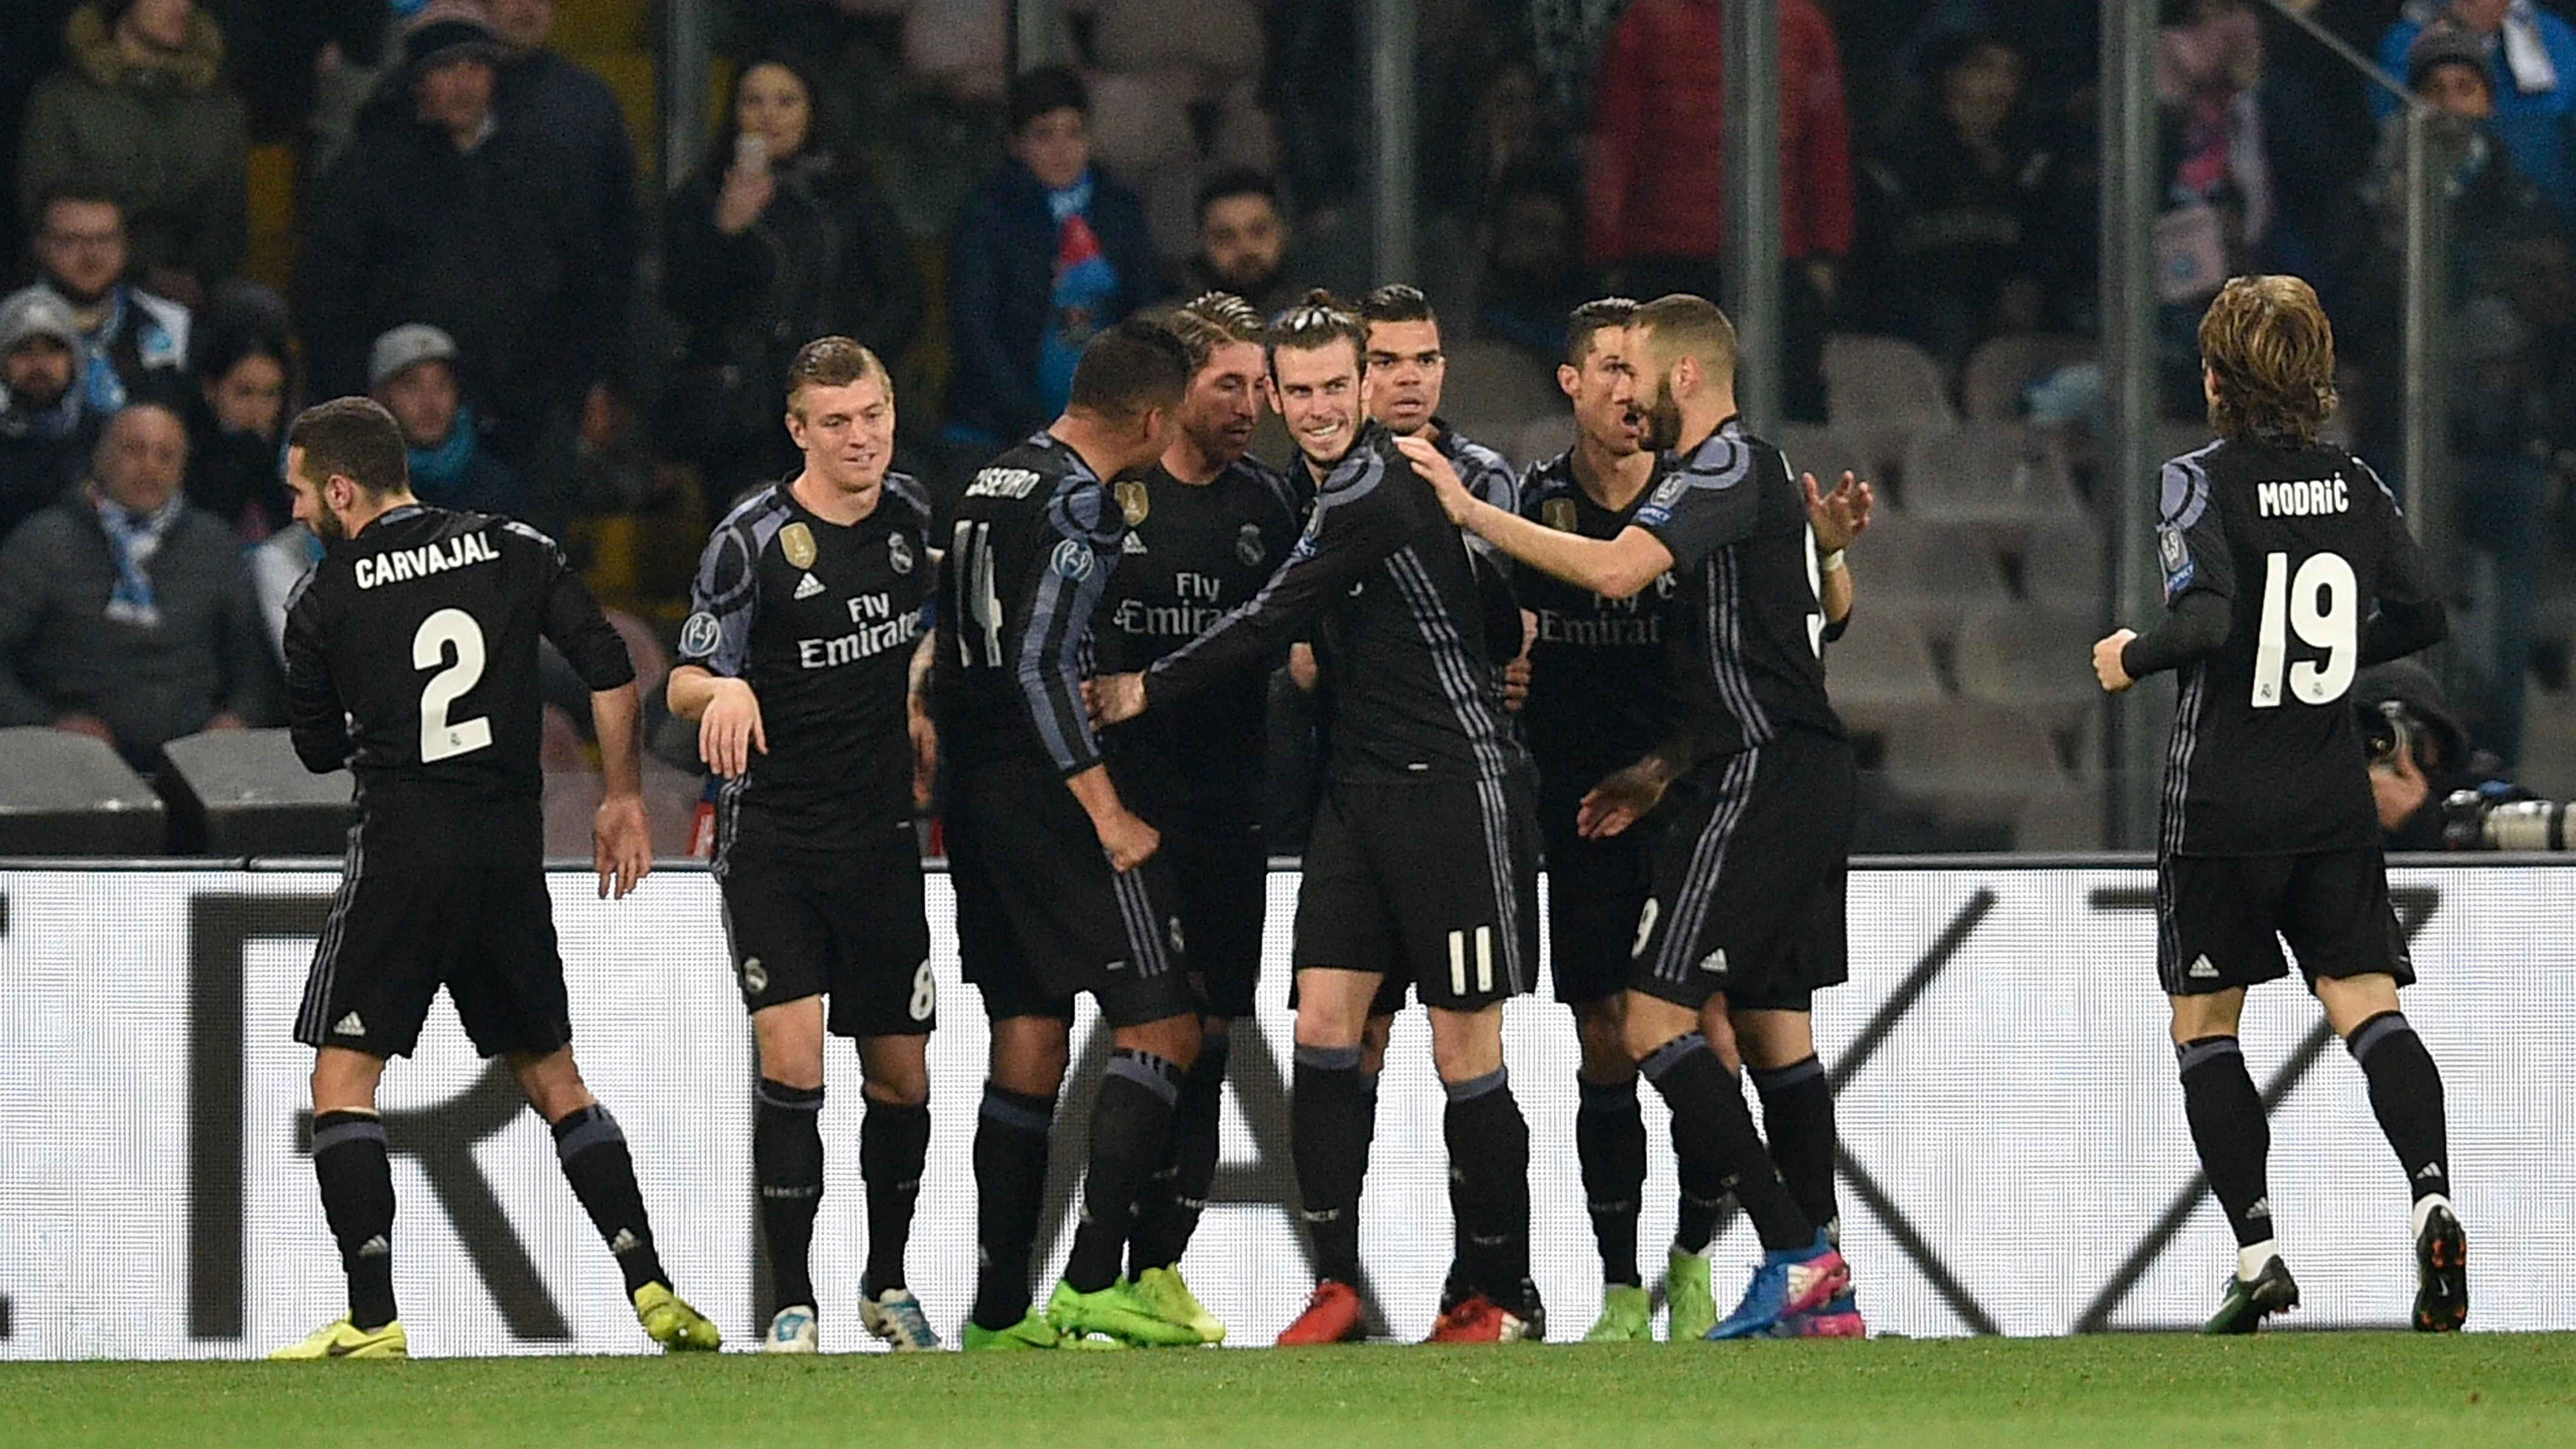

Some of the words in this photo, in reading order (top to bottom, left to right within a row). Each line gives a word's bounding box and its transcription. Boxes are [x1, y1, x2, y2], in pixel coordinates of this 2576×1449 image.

[355, 531, 500, 589] CARVAJAL
[1176, 572, 1220, 602] Fly
[847, 592, 889, 623] Fly
[1113, 598, 1233, 635] Emira
[2251, 552, 2357, 708] 19
[798, 608, 924, 668] Emirate
[413, 608, 492, 763] 2
[909, 958, 934, 1021] 8
[1449, 926, 1492, 995] 11
